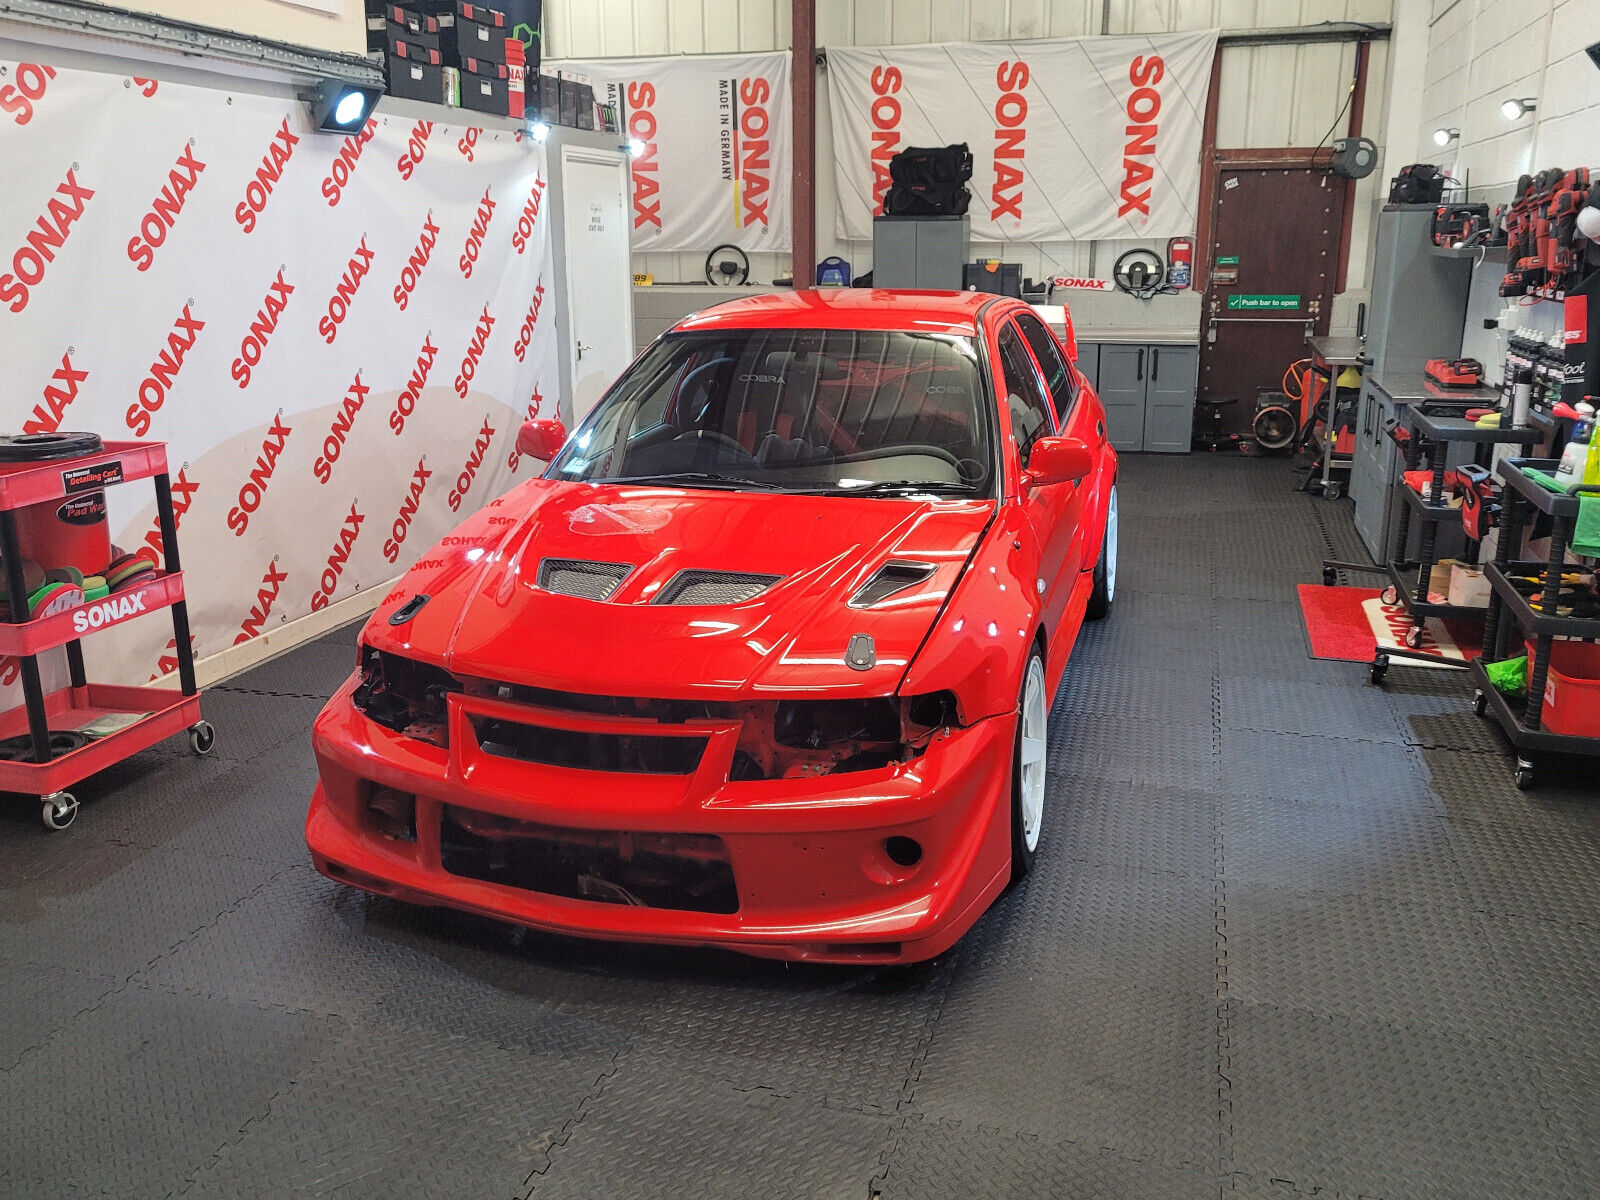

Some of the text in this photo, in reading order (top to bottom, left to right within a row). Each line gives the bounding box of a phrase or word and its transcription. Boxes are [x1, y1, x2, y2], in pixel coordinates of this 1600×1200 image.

[235, 118, 299, 234] SONAX
[628, 81, 662, 230] SONAX
[719, 79, 732, 181] MADE IN GERMANY
[740, 77, 770, 228] SONAX
[990, 60, 1030, 222] SONAX
[1117, 55, 1166, 219] SONAX
[0, 168, 95, 313] SONAX
[127, 143, 206, 272] SONAX
[459, 188, 496, 279] SONAX
[512, 168, 546, 254] SONAX
[319, 236, 374, 344] SONAX
[394, 213, 440, 311] SONAX
[1054, 277, 1107, 289] SONAX
[126, 304, 205, 437] SONAX
[231, 269, 294, 389] SONAX
[455, 306, 495, 399] SONAX
[514, 276, 545, 362] SONAX
[314, 372, 370, 485] SONAX
[389, 335, 438, 436] SONAX
[740, 374, 786, 384] COBRA
[70, 473, 102, 486] Detailing
[102, 469, 117, 478] Cart
[227, 413, 292, 537] SONAX
[383, 459, 432, 563] SONAX
[448, 417, 495, 512] SONAX
[311, 503, 365, 613] SONAX
[72, 591, 147, 632] SONAX
